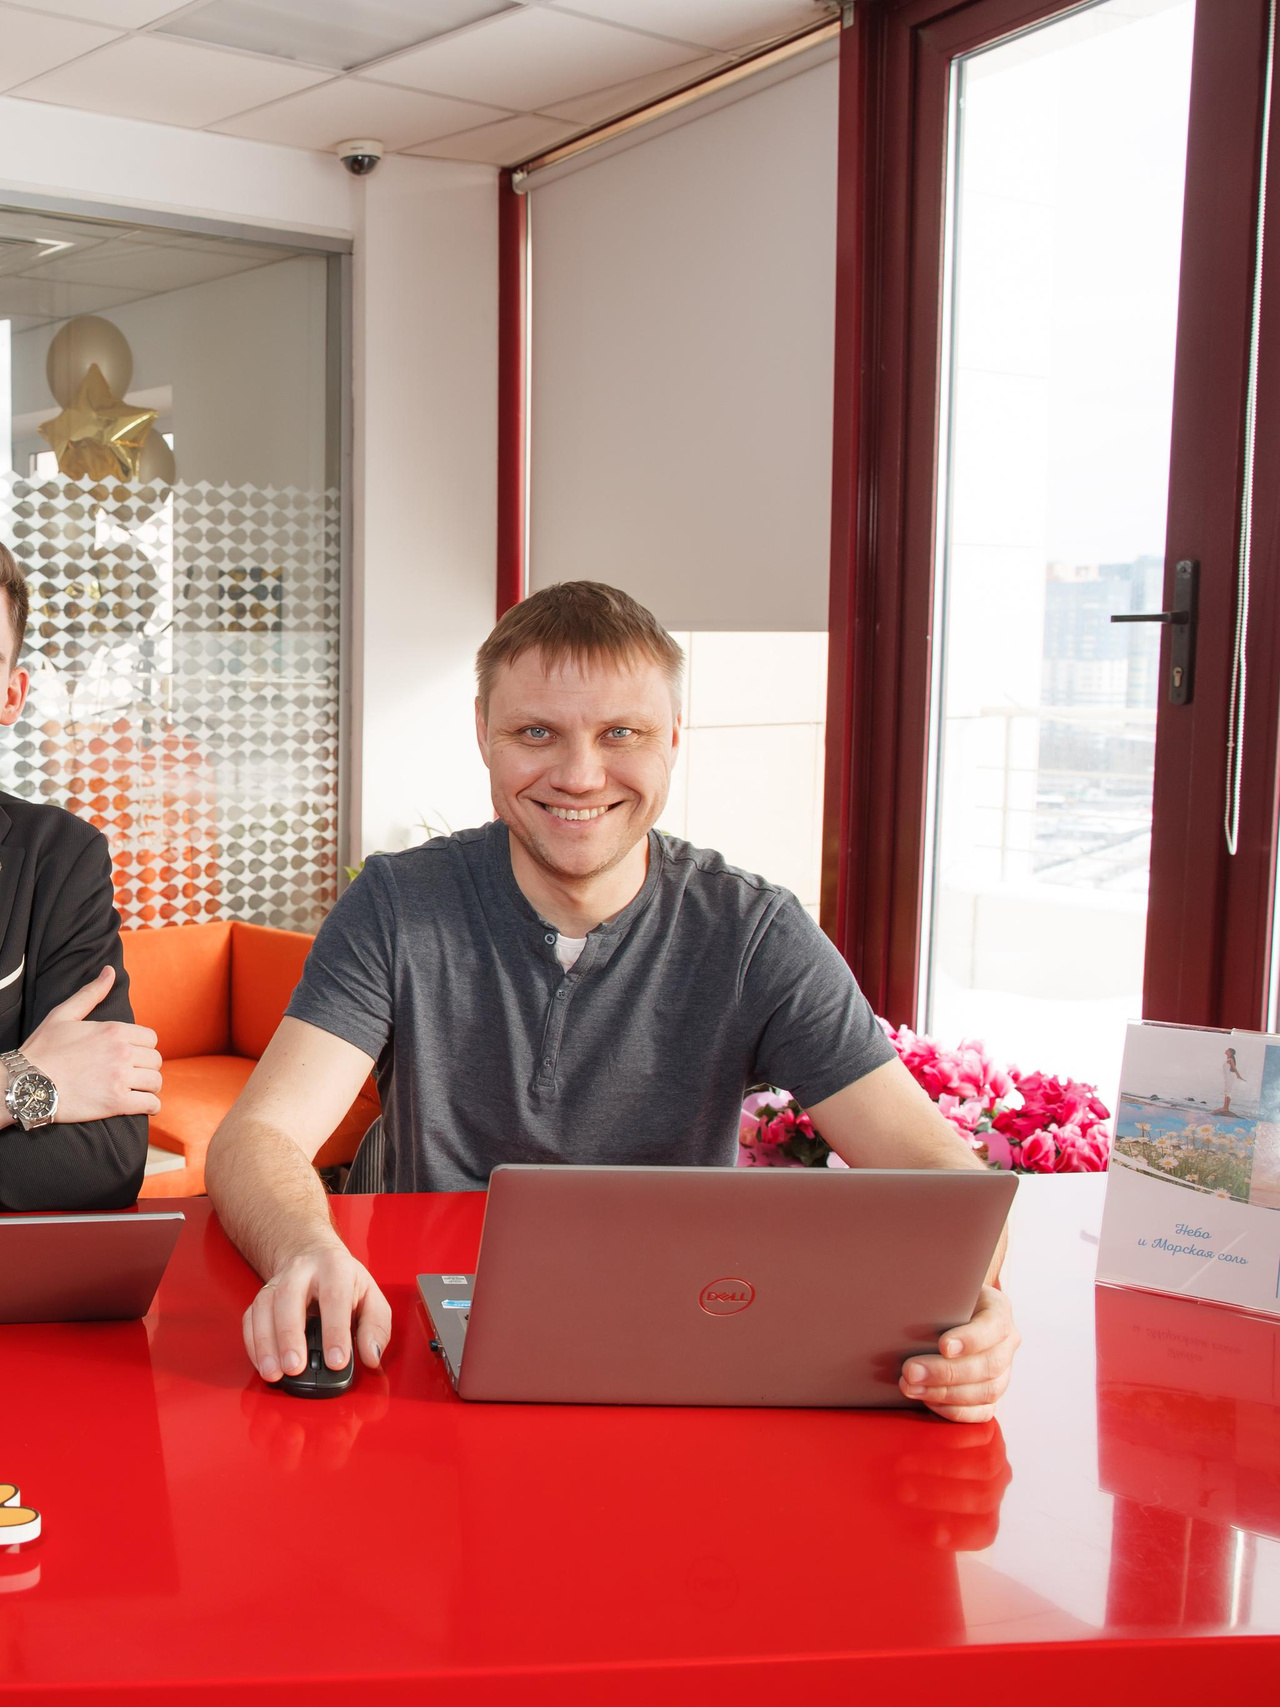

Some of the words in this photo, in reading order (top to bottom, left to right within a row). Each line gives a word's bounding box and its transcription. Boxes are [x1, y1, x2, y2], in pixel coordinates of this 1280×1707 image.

[1175, 1223, 1212, 1239] Небо
[1137, 1238, 1147, 1246] и
[1151, 1238, 1215, 1259] Морская
[1217, 1252, 1249, 1265] соль
[706, 1291, 749, 1302] DELL
